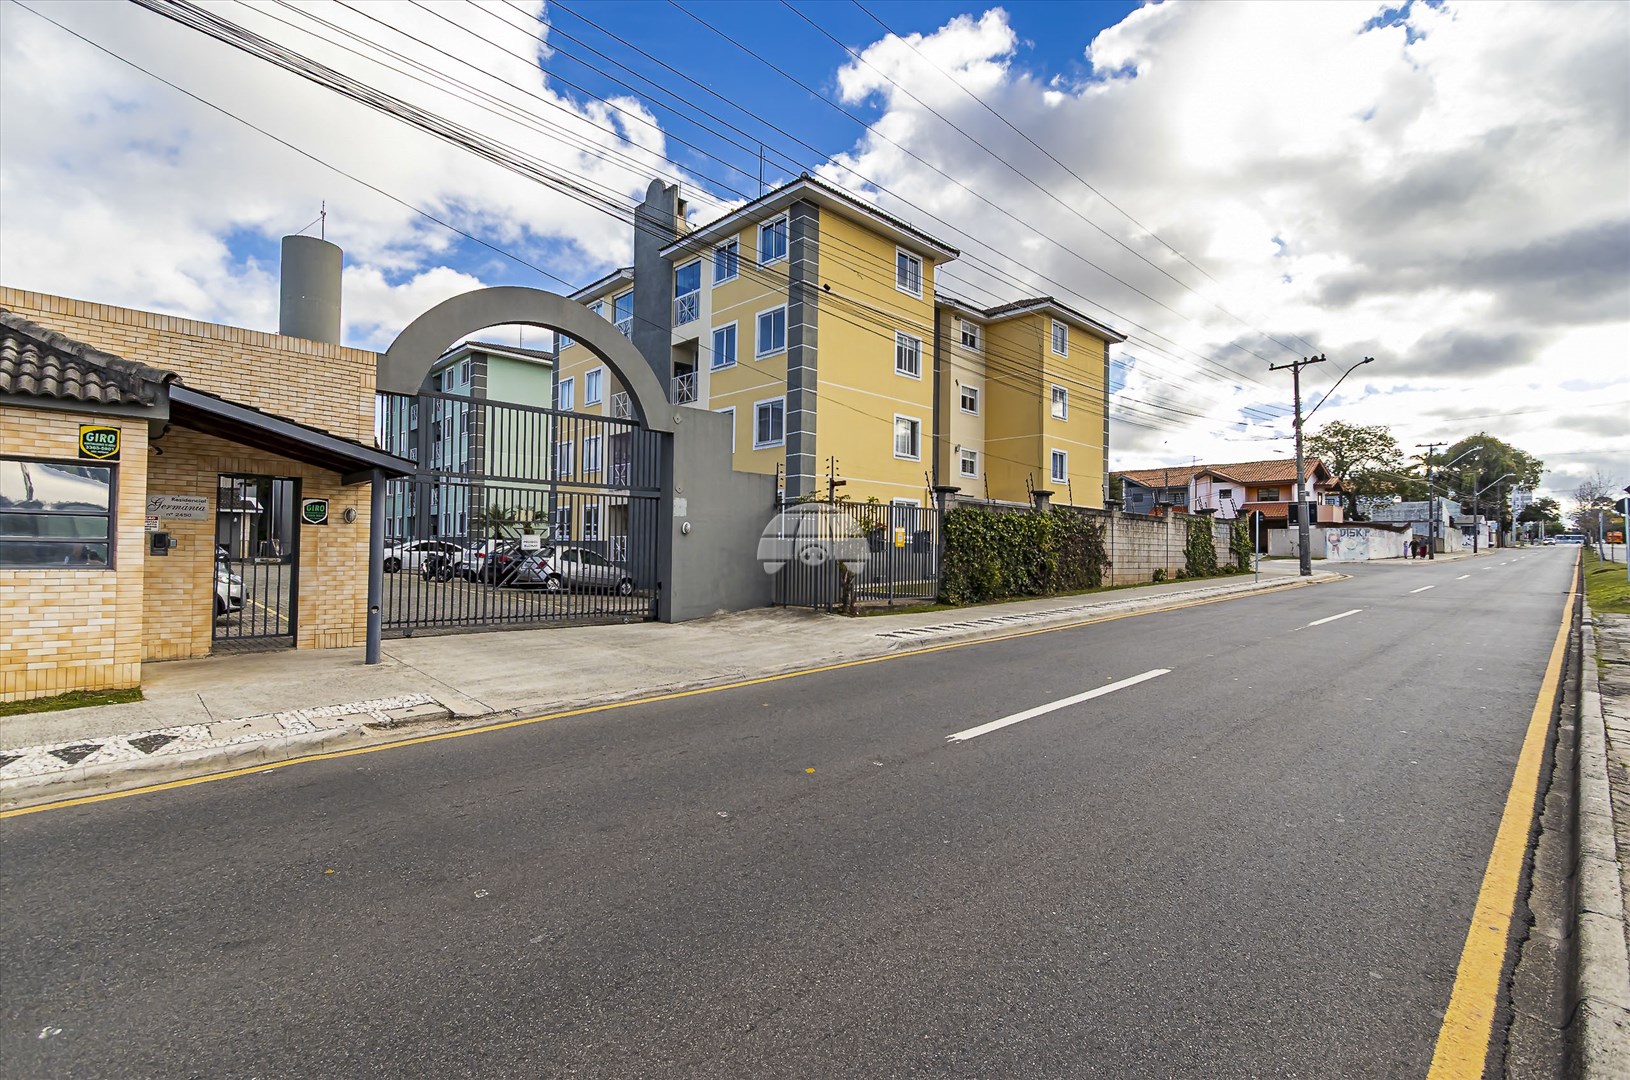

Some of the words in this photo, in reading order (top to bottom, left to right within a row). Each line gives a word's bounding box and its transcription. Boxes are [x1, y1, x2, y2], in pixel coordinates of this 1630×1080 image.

[86, 432, 115, 443] GIRO
[306, 504, 325, 512] GIRO
[1340, 528, 1362, 537] DISK
